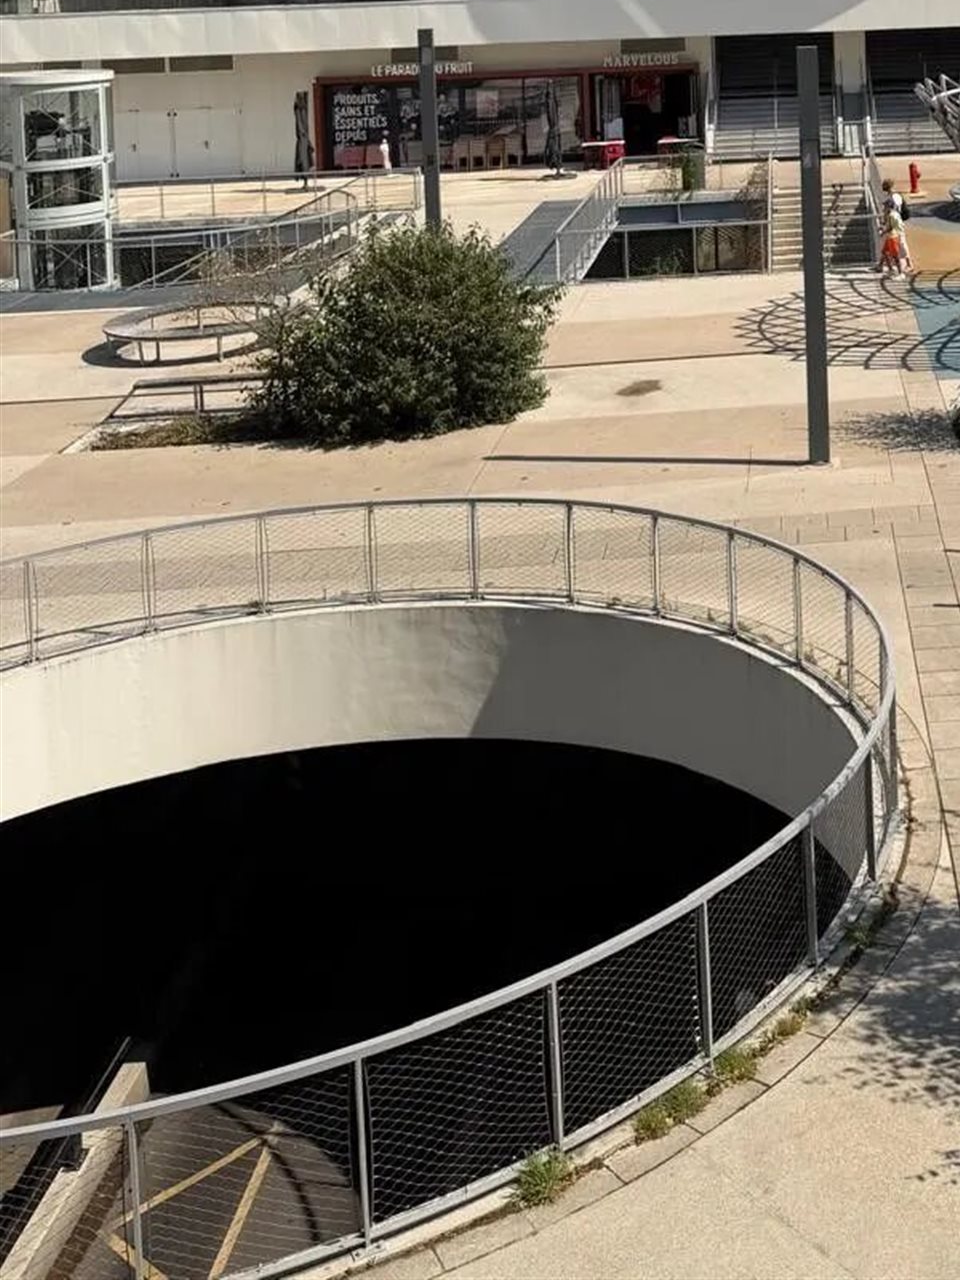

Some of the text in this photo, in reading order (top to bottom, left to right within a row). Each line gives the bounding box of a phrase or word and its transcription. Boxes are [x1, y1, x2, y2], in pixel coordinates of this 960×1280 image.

[603, 52, 679, 67] MARVELOUS
[371, 64, 383, 77] LE
[385, 63, 420, 76] PARAD
[445, 61, 473, 74] FRUIT
